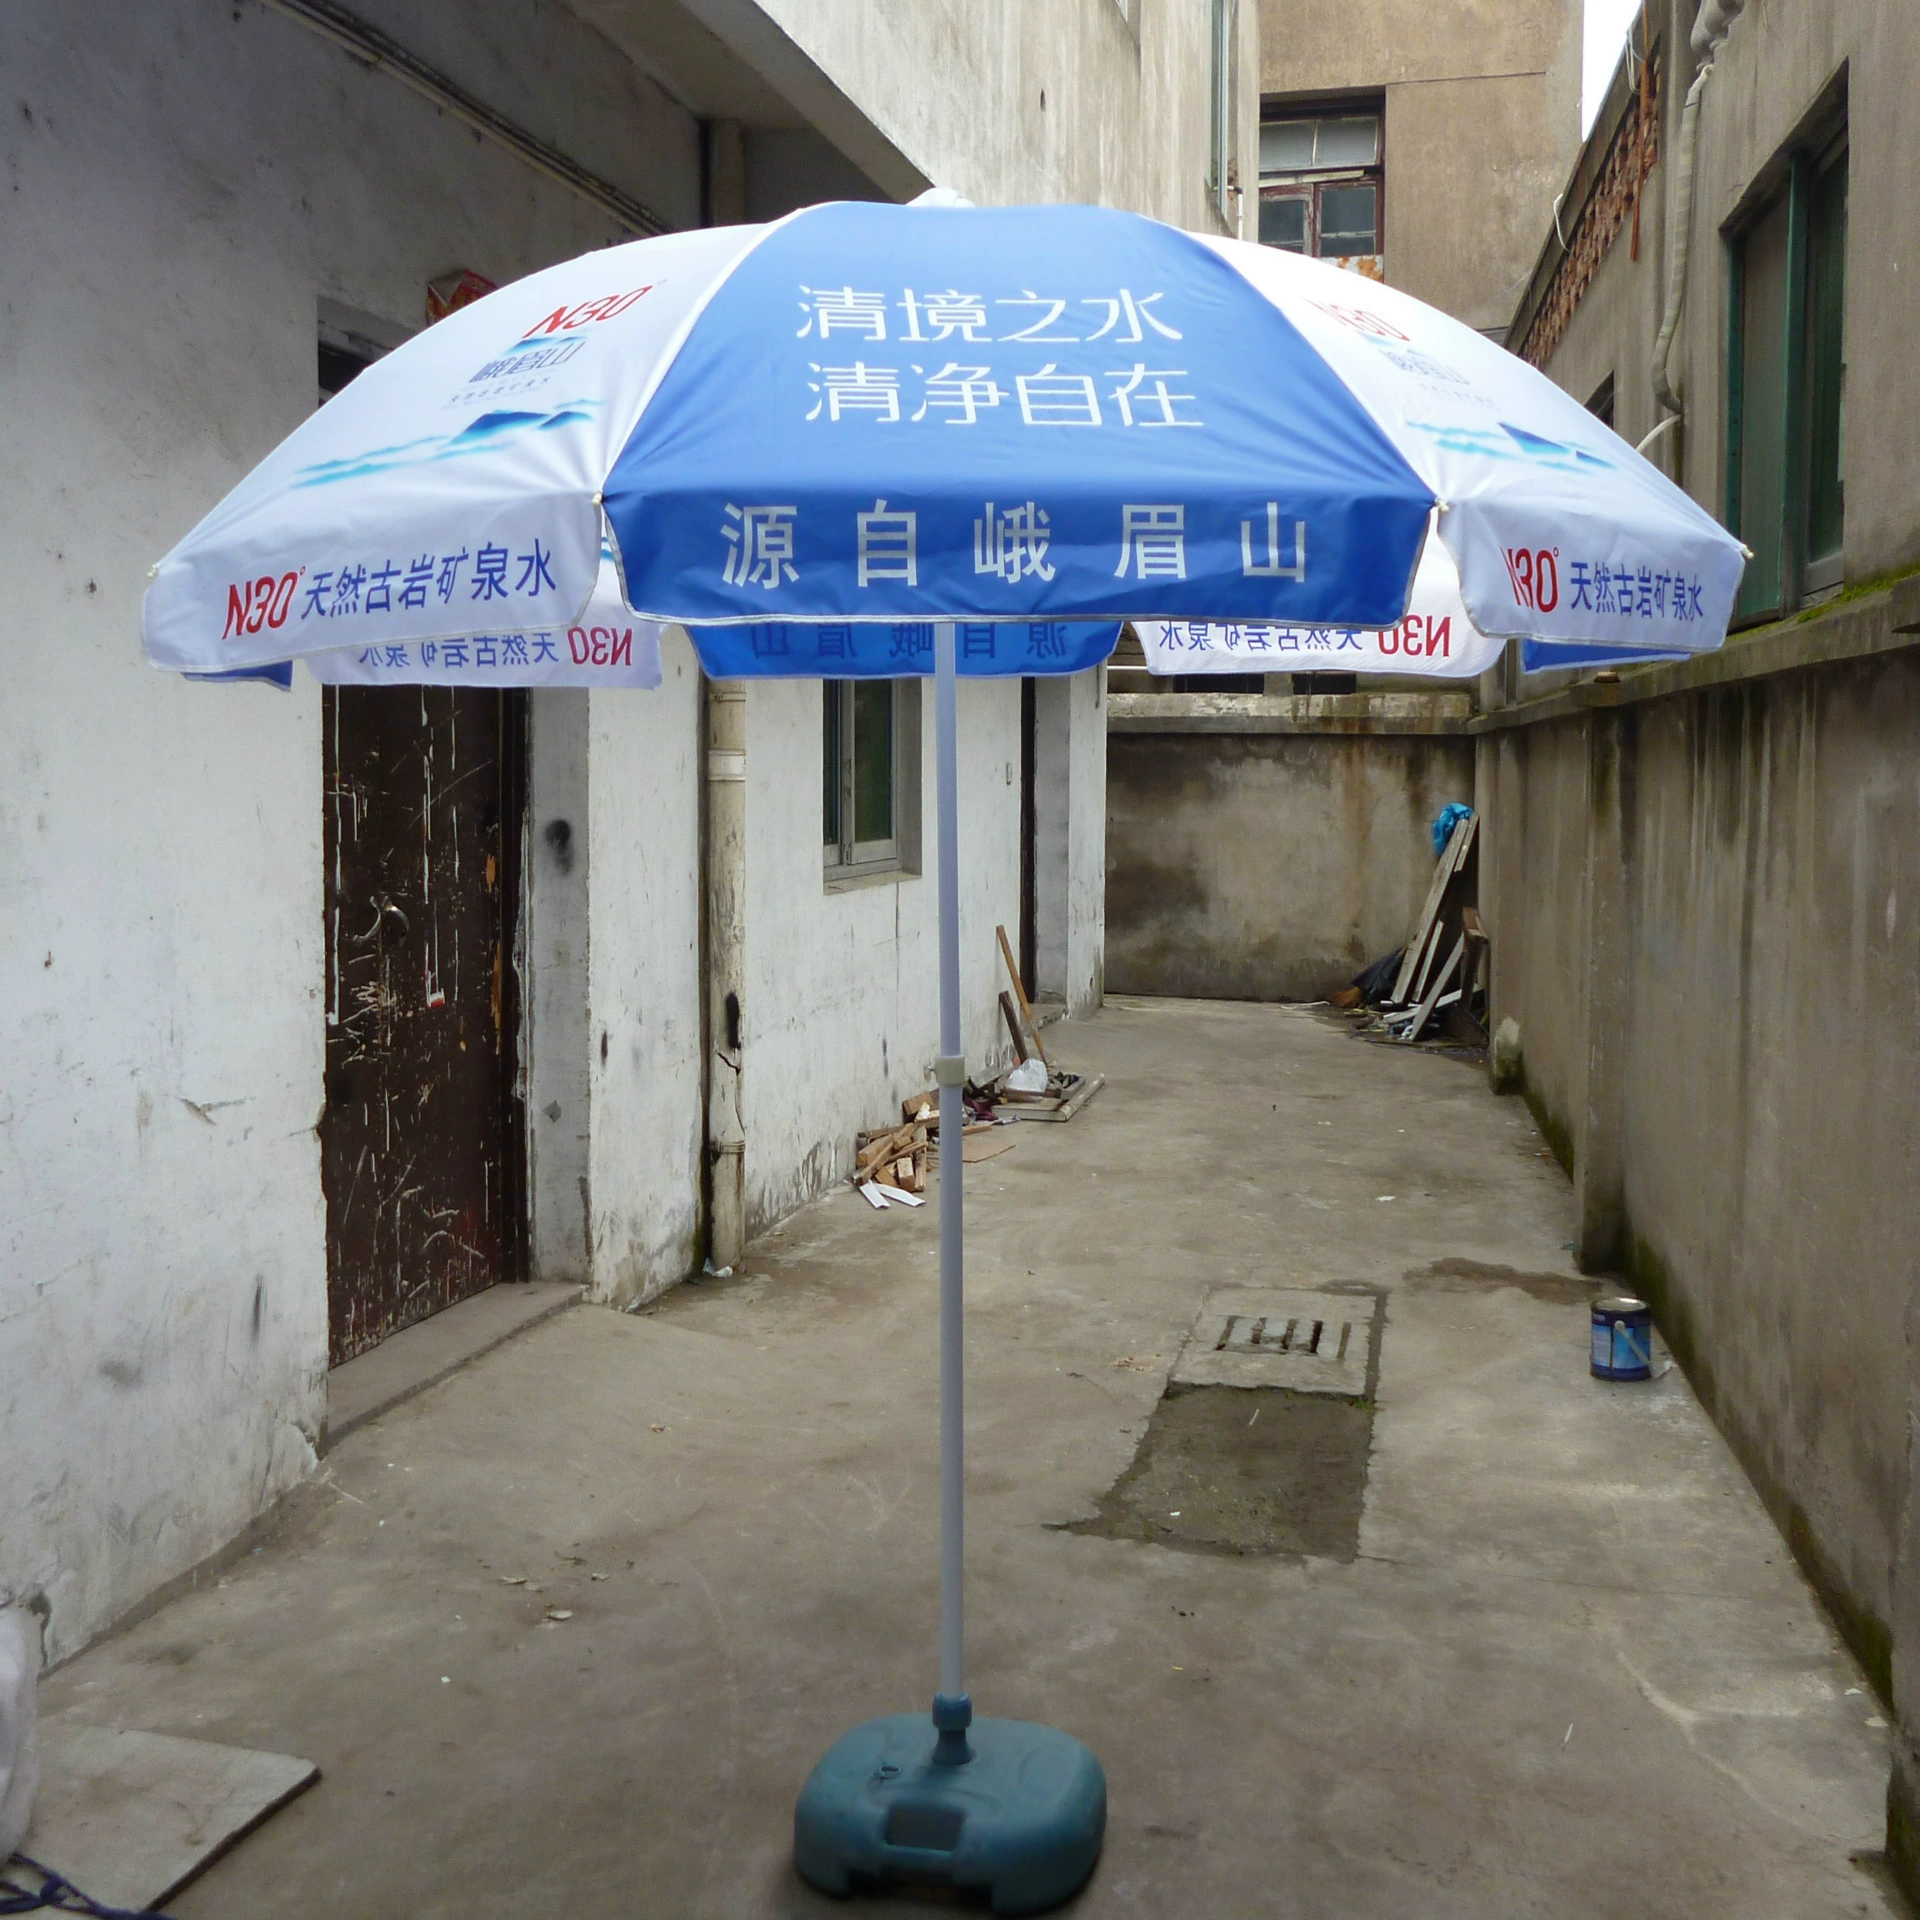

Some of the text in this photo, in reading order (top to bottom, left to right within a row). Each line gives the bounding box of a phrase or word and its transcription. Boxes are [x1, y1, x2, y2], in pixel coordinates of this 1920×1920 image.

[797, 286, 1183, 342] 清境之水
[806, 361, 1204, 426] 清净自在
[720, 499, 1306, 589] 源自峨眉山
[301, 538, 556, 620] 天然古岩矿泉水
[1571, 562, 1703, 622] 天然古岩矿泉水
